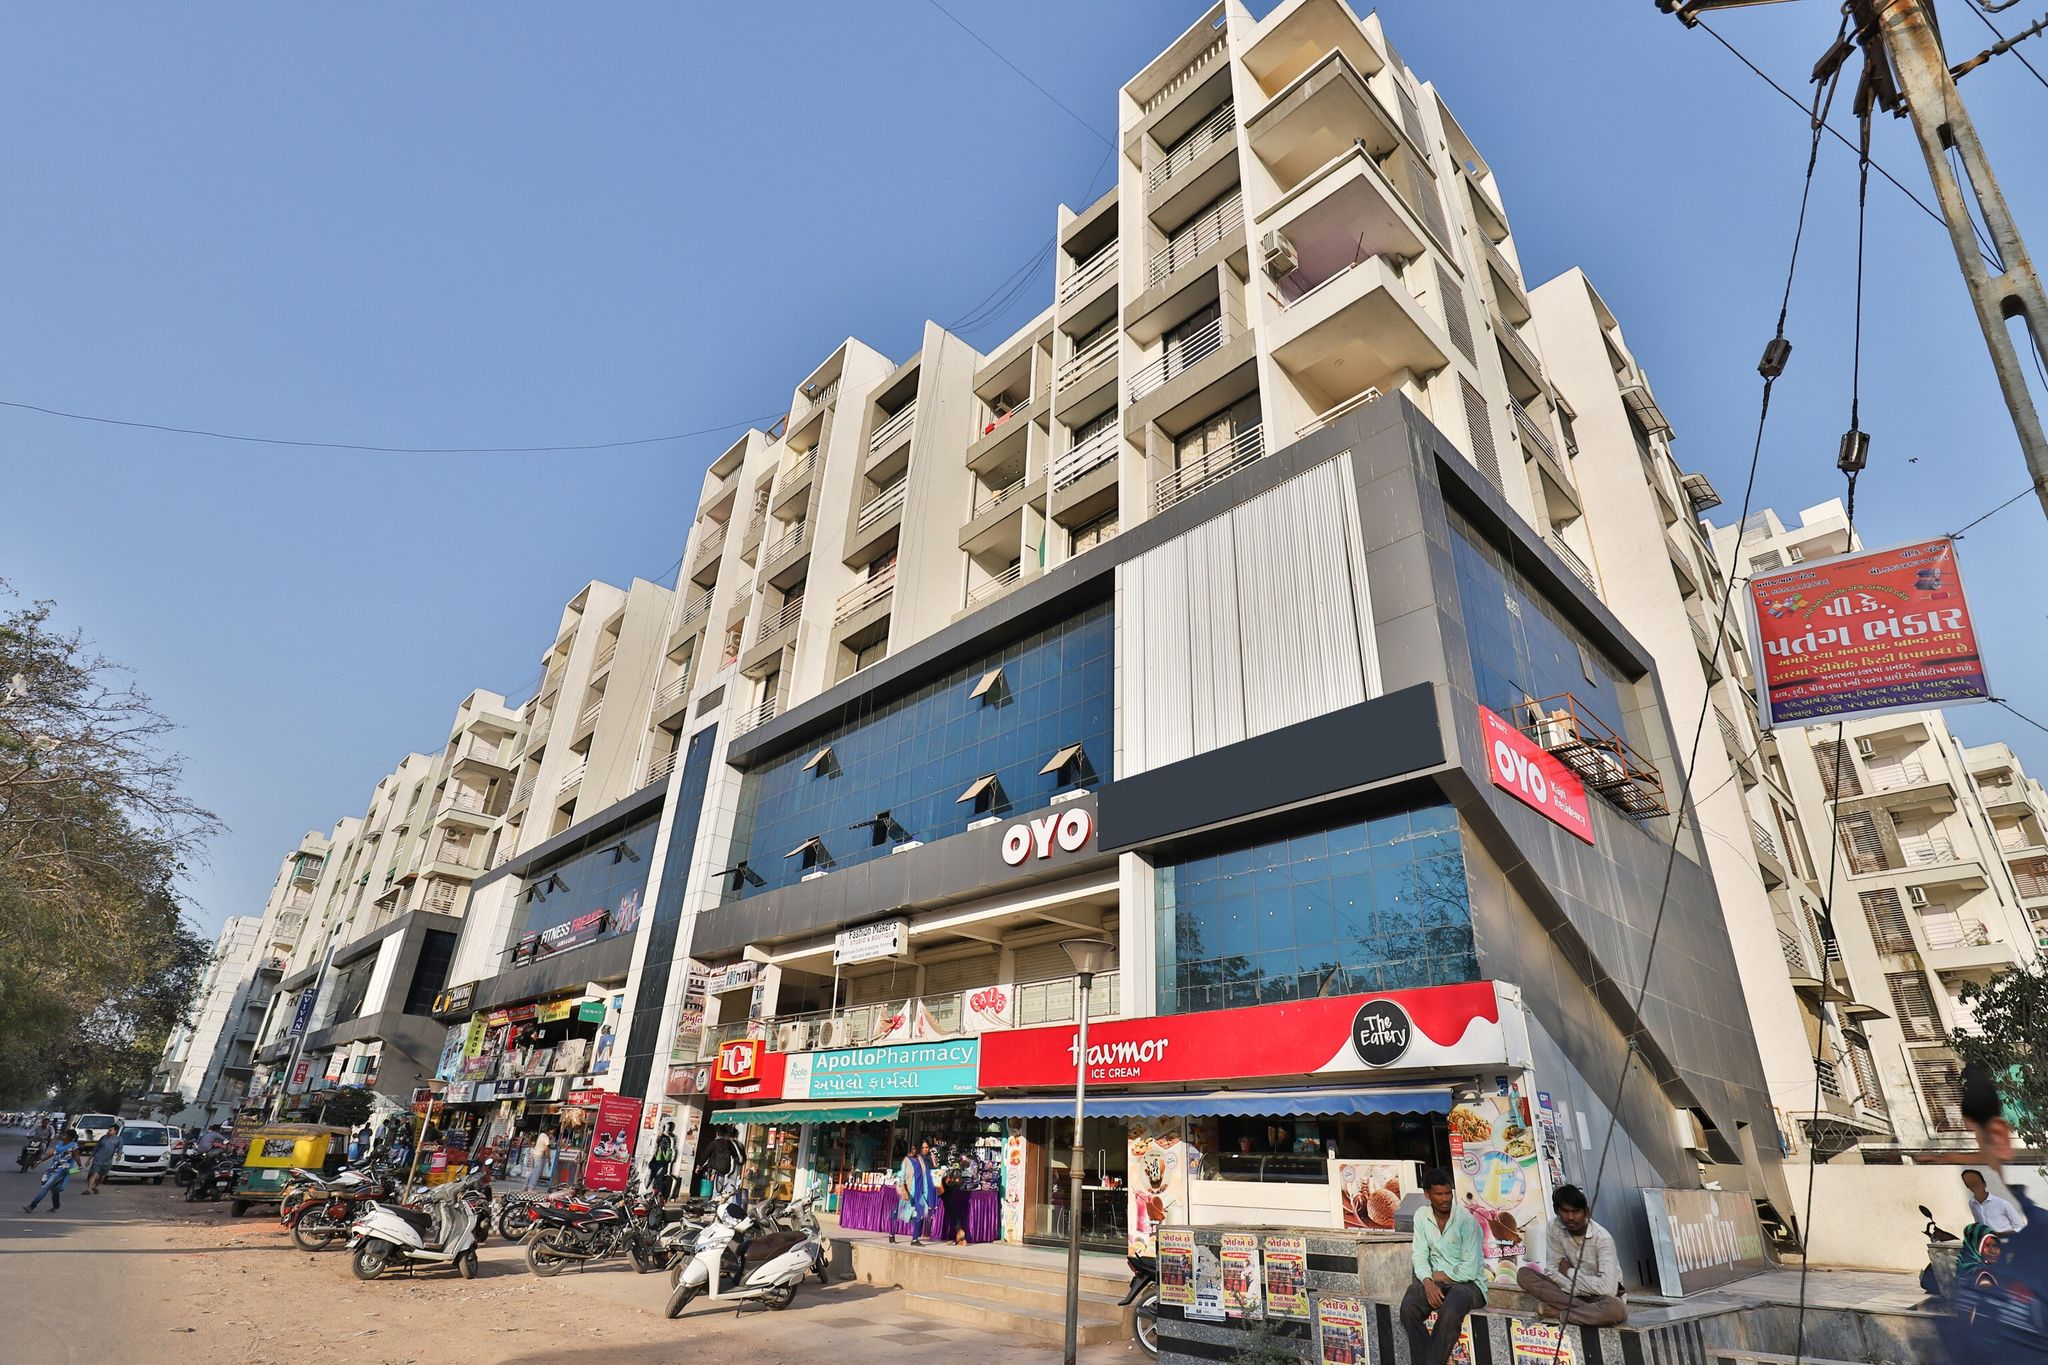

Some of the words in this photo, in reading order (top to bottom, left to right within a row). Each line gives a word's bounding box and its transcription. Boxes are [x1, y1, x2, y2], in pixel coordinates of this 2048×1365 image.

[1821, 592, 1887, 617] પી.કે.
[1765, 623, 1852, 657] પતંગ
[1863, 607, 1967, 641] ભંડાર
[1776, 653, 1810, 666] અમારે
[1837, 639, 1890, 656] મનપસંદ
[1932, 631, 1961, 642] તથા
[1954, 641, 1972, 653] છે.
[1820, 670, 1855, 681] મનગમતા
[1826, 681, 1841, 690] તથા
[1862, 675, 1882, 684] પતંગ
[1494, 739, 1547, 804] OYO
[1554, 796, 1586, 827] Residency
[1002, 807, 1093, 866] OYO
[540, 921, 571, 944] FITNESS
[849, 927, 872, 939] Fashion
[871, 931, 895, 941] BOUTIQUE
[971, 988, 1004, 1012] SALE
[293, 997, 311, 1030] VIVAN
[582, 1008, 602, 1017] oppo
[1364, 1013, 1393, 1031] The
[470, 1024, 482, 1054] XEROX
[1359, 1025, 1407, 1048] Eatery
[720, 1044, 753, 1076] TGB
[816, 1047, 974, 1072] ApolloPharmacy
[814, 1073, 864, 1090] અપોલો
[868, 1072, 919, 1088] ફાર્મસી
[1092, 1068, 1105, 1078] ICE
[1108, 1067, 1141, 1078] CREAM
[953, 1084, 973, 1092] Raysan
[1162, 1233, 1182, 1243] જોઈએ
[1184, 1233, 1191, 1242] છે
[1223, 1238, 1245, 1247] જોઈએ
[1247, 1238, 1254, 1247] છે
[1267, 1239, 1291, 1248] જોઈએ
[1293, 1237, 1300, 1248] છે
[1322, 1300, 1348, 1311] જોઈએ
[1351, 1302, 1360, 1312] છે
